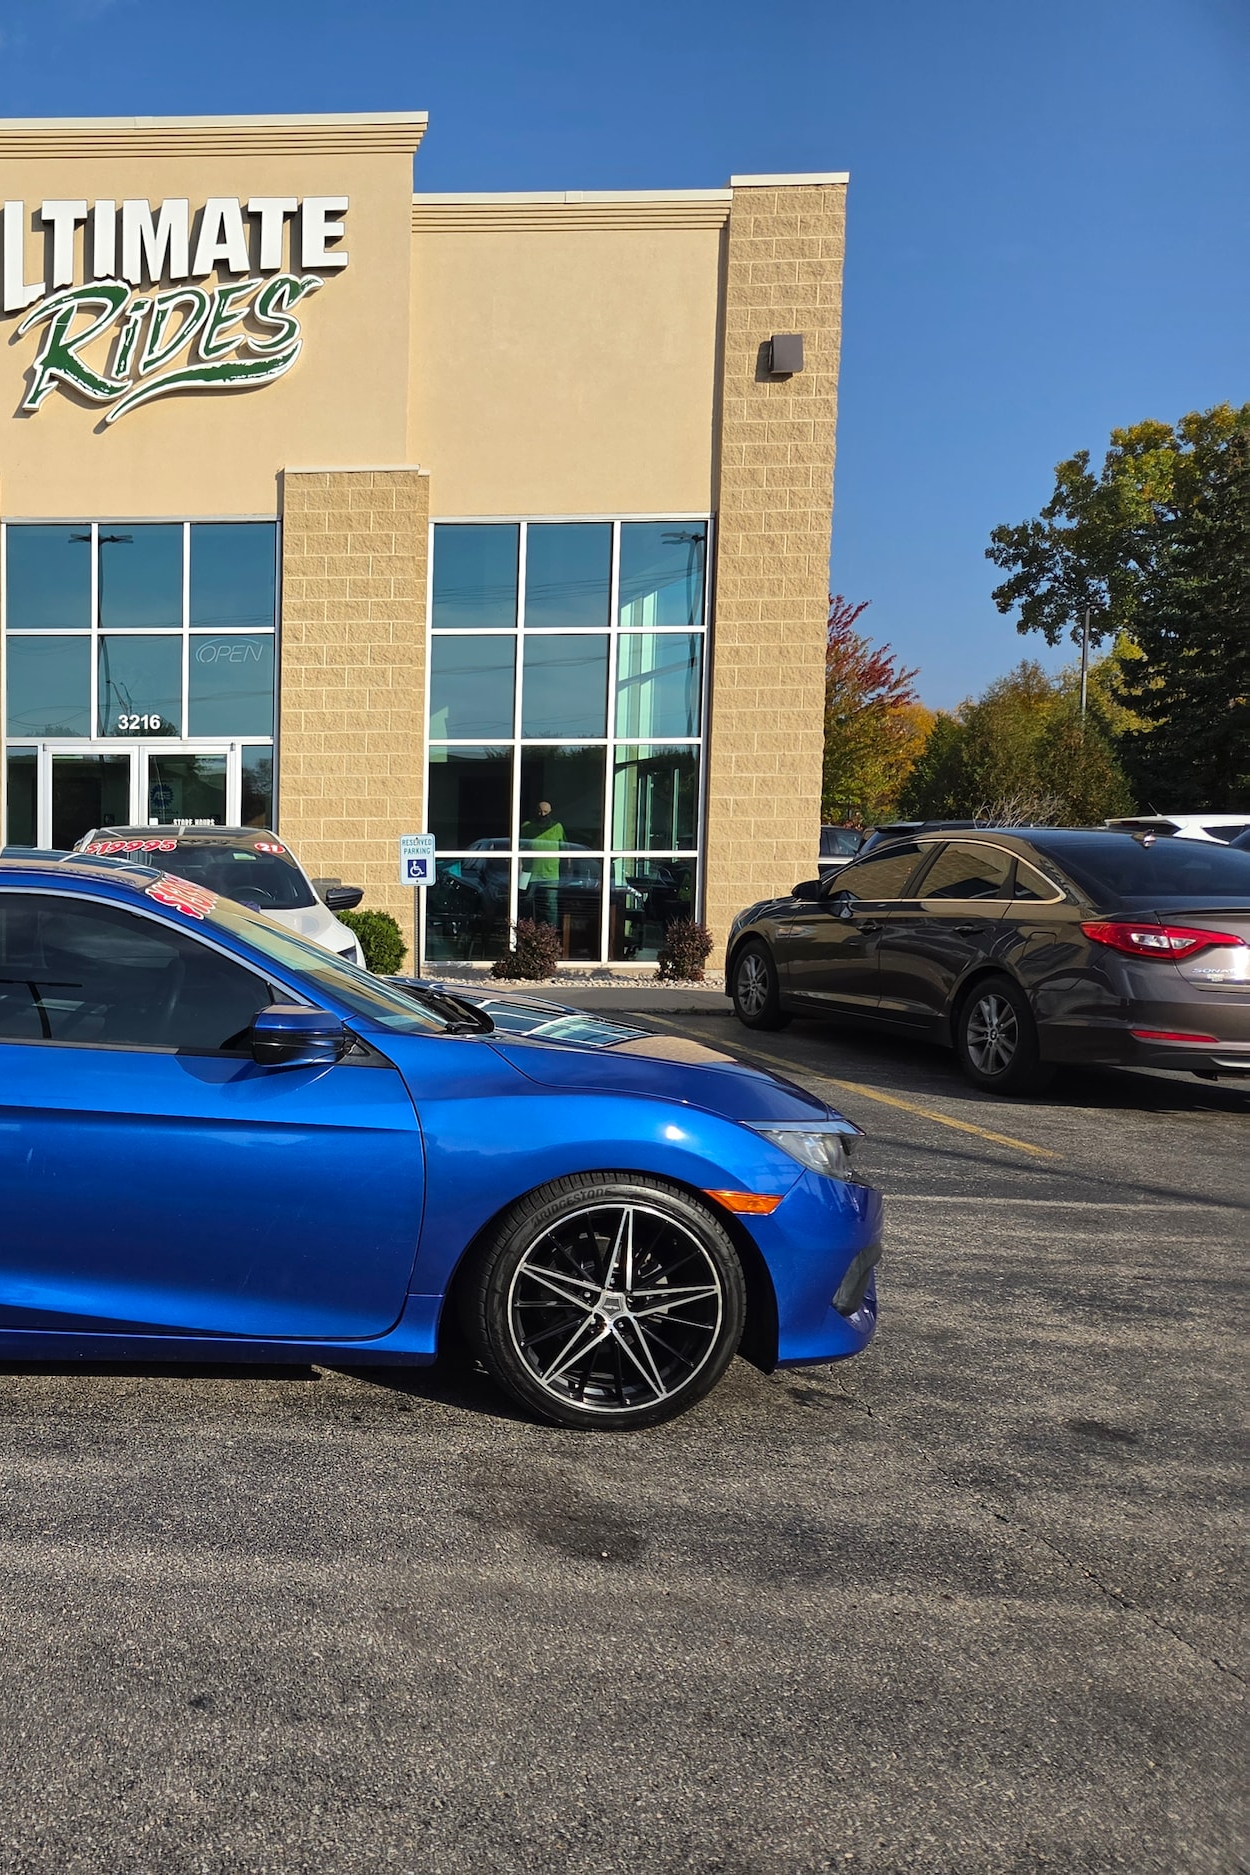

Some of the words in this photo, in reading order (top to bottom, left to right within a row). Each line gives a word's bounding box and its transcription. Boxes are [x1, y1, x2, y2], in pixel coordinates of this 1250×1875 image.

[199, 644, 264, 663] OPEN
[118, 714, 161, 730] 3216
[173, 818, 193, 826] STORE
[85, 839, 178, 855] $19995
[260, 842, 278, 853] 21
[402, 838, 432, 846] RESERVED
[1192, 967, 1240, 976] SONAT
